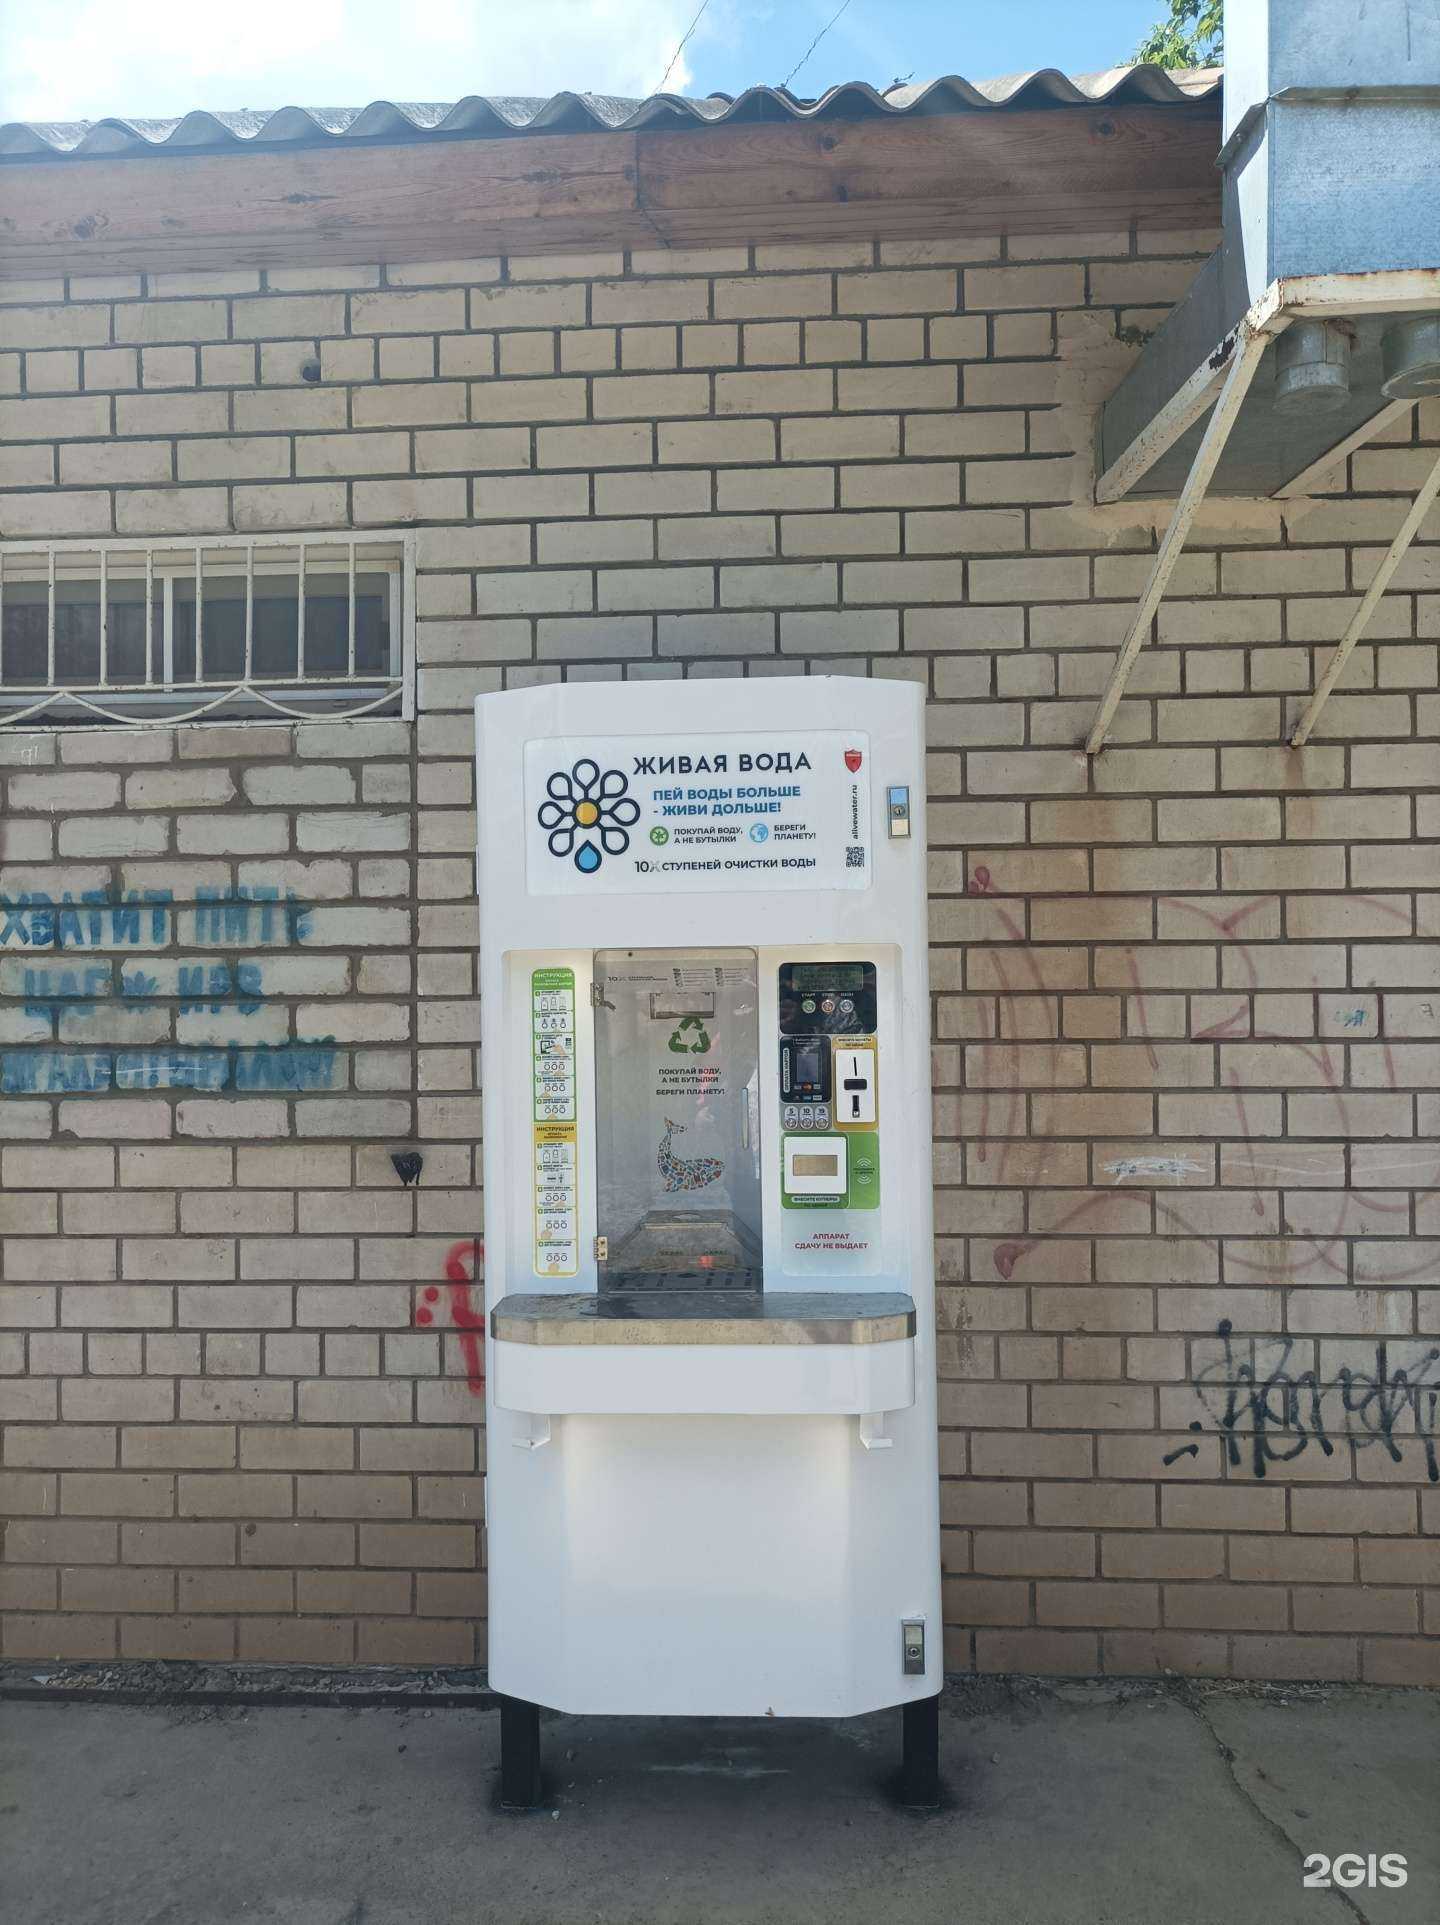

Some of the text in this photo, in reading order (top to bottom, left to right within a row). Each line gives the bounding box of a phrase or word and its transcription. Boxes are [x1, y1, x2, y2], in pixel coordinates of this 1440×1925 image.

[633, 752, 812, 775] ЖИВАЯ ВОДА
[653, 786, 801, 801] ПЕЙ ВОДЫ БОЛЬШЕ
[662, 804, 708, 816] ЖИВИ
[712, 802, 782, 816] ДОЛЬШЕ!
[674, 827, 743, 835] ПОКУПАЙ ВОДУ,
[774, 832, 816, 840] ПЛАНЕТУ!
[662, 859, 721, 871] СТУПЕНЕЙ
[724, 859, 778, 869] ОЧИСТКИ
[781, 858, 816, 868] ВОДЫ
[658, 1067, 696, 1075] ПОКУПАЙ
